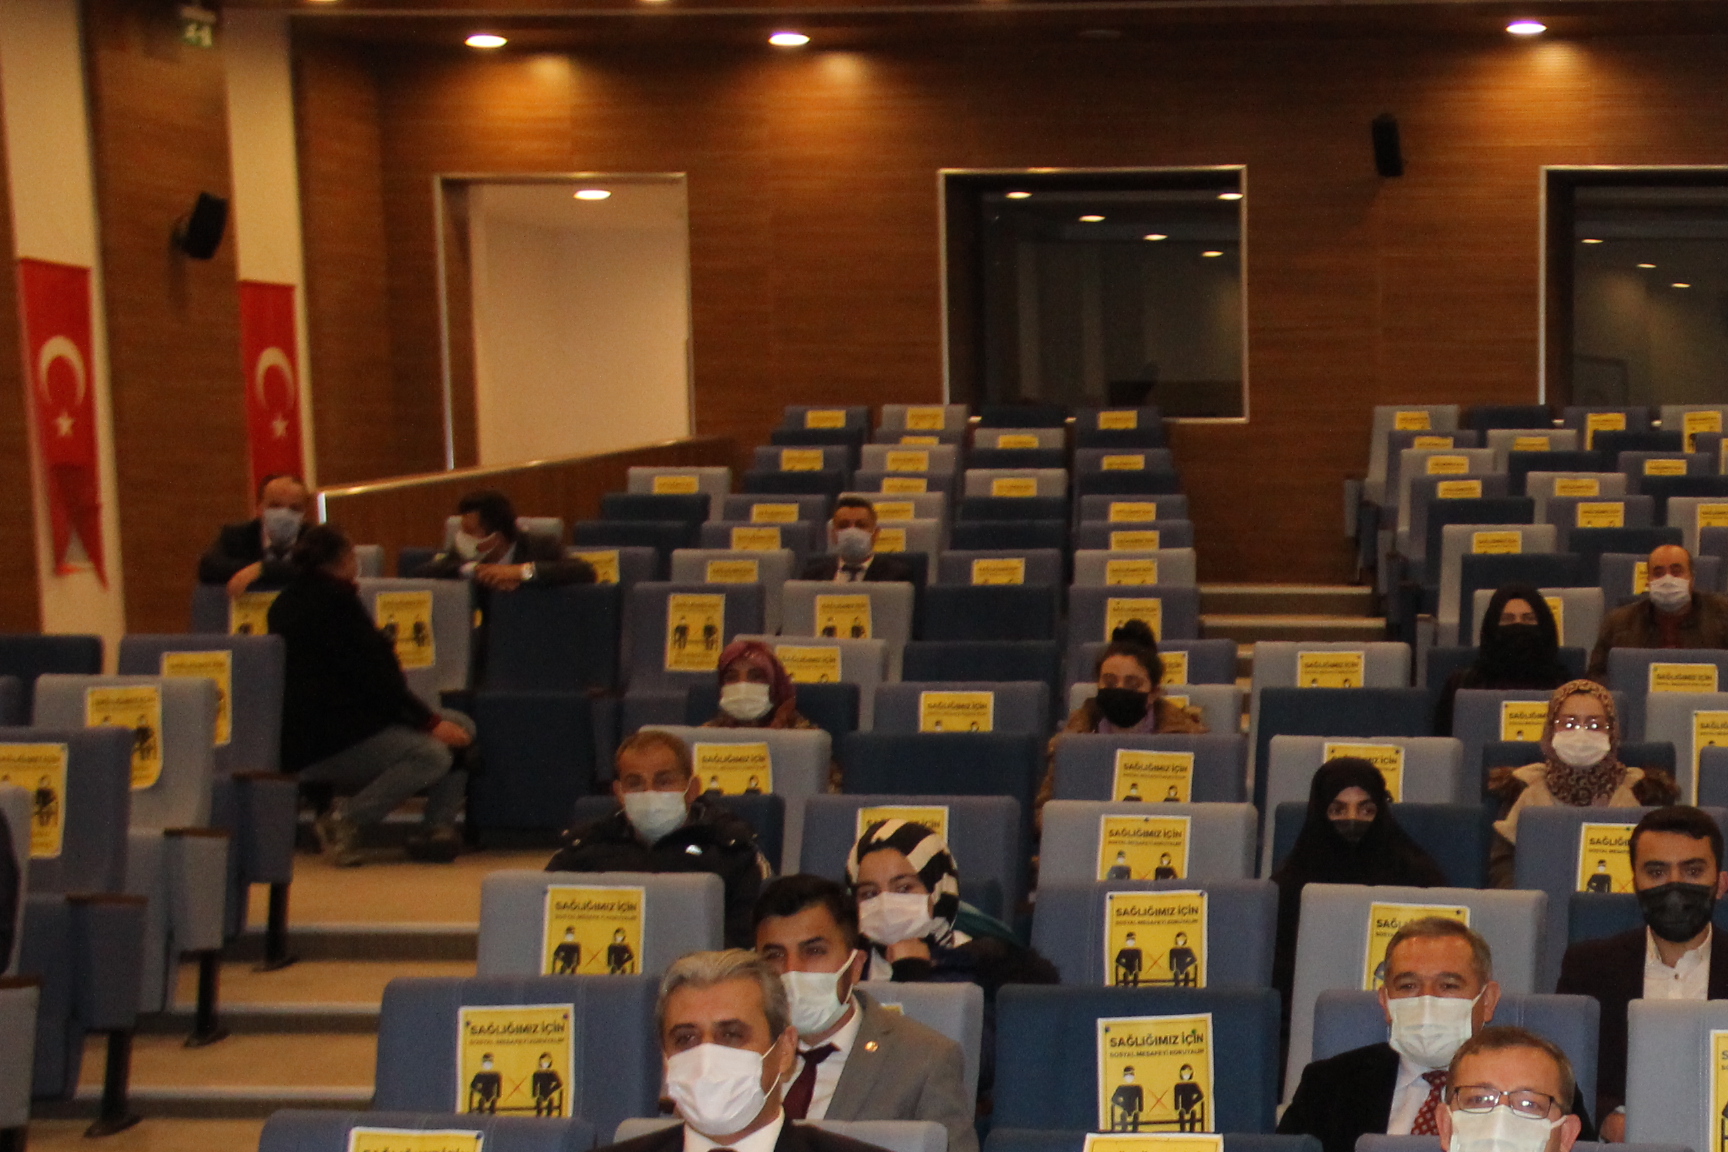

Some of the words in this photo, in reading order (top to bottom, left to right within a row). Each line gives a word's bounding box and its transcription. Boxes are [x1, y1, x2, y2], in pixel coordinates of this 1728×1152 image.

[1116, 906, 1176, 916] SAĞLIĞIMIZ
[1178, 904, 1198, 917] İÇİN
[1110, 1034, 1178, 1048] SAĞLIĞIMIZ
[1182, 1031, 1204, 1046] İÇİN
